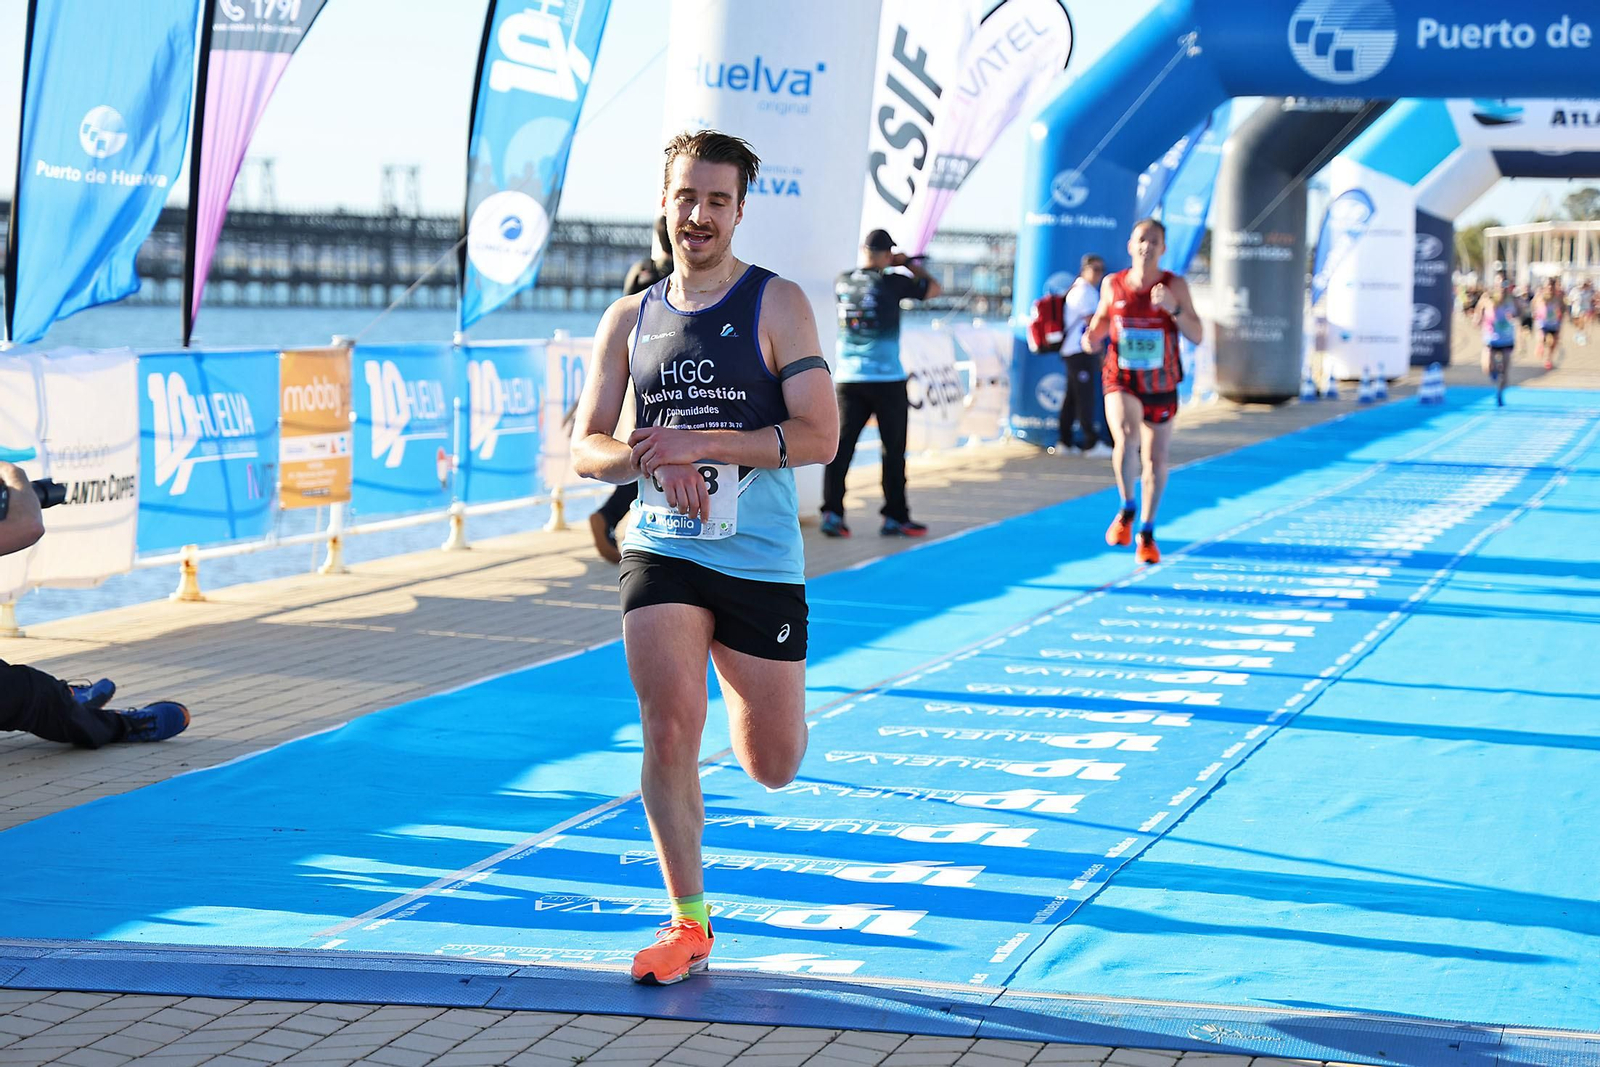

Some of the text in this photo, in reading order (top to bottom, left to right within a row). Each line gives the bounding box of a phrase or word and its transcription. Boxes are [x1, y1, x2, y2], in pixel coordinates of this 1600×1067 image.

[1416, 14, 1592, 49] Puerto de
[868, 24, 943, 214] CSIF
[36, 160, 168, 188] Puerto de Huelva
[661, 359, 715, 386] HGC
[284, 374, 342, 417] mobby
[688, 385, 746, 400] Gestión
[364, 360, 411, 459] 10
[147, 371, 199, 488] 10
[190, 392, 256, 438] HUELVA
[709, 421, 720, 429] 959
[1086, 710, 1194, 728] 10
[877, 726, 1163, 752] 10 HUELVA
[824, 751, 1012, 771] HUELVA
[1002, 760, 1127, 781] 10
[763, 786, 964, 804] HUELVA
[953, 790, 1086, 814] 10
[895, 824, 1040, 847] 10
[619, 854, 986, 888] 10 HUELA
[764, 904, 929, 937] 10
